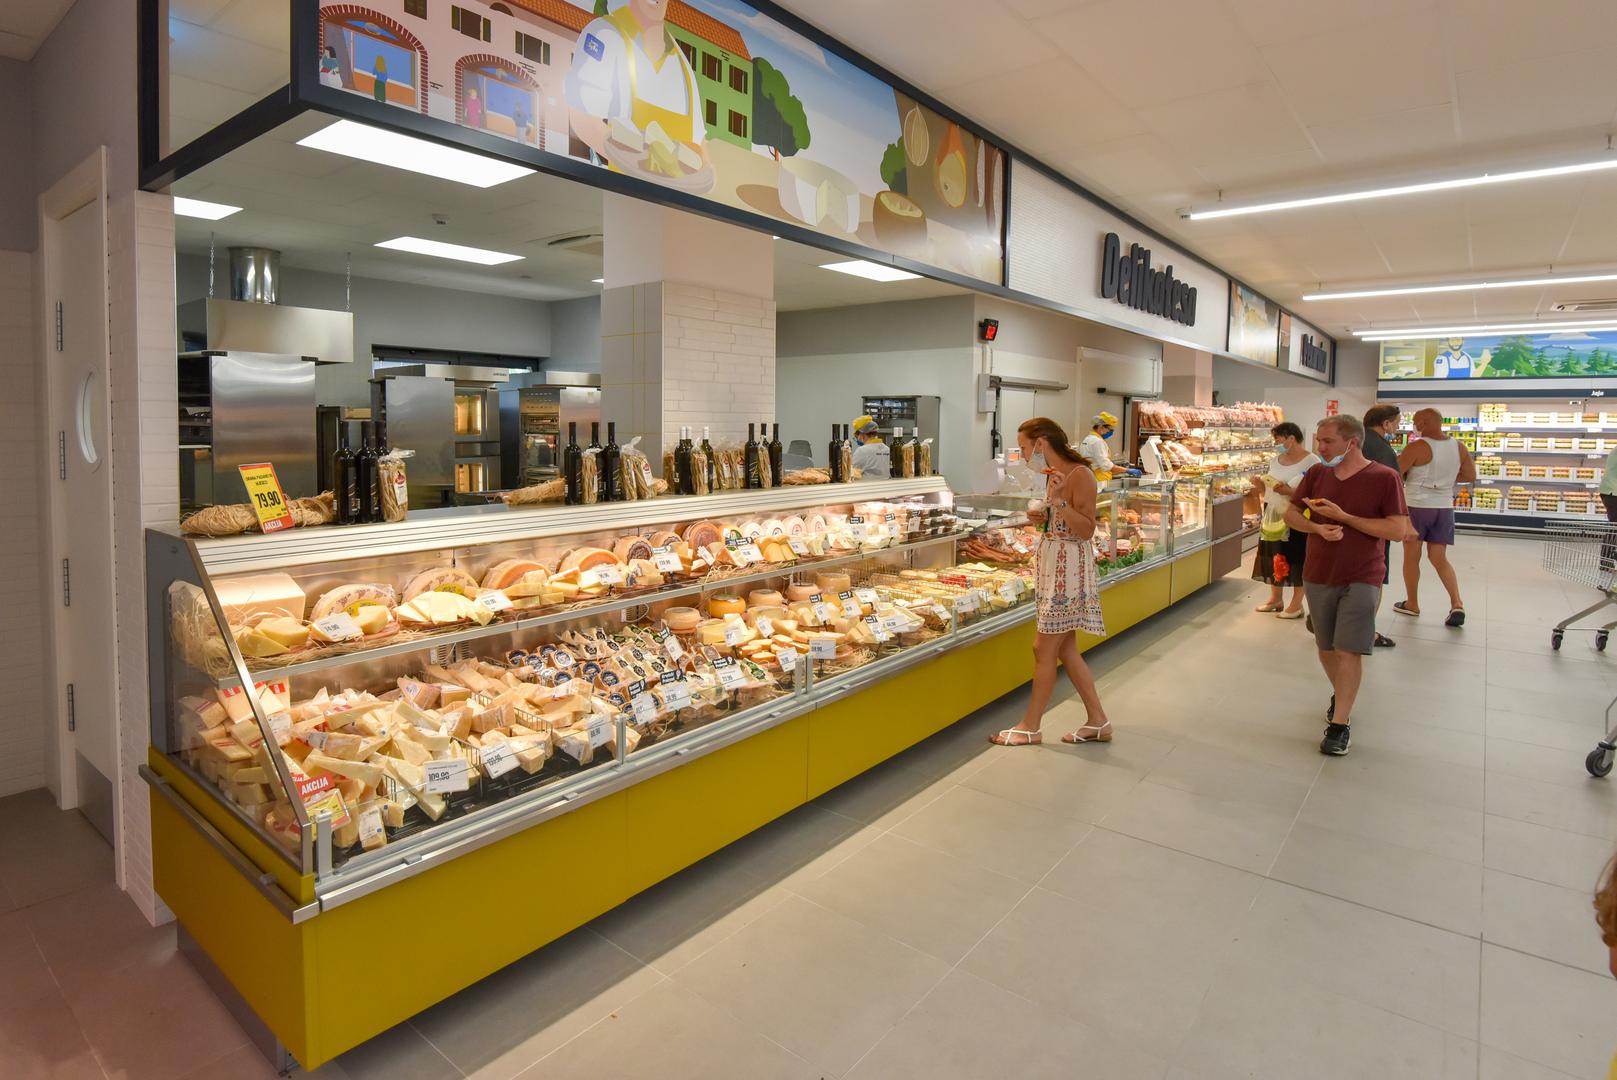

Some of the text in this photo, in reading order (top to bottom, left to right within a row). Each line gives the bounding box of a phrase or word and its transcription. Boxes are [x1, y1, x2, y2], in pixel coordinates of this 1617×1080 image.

[1101, 232, 1197, 327] Delikatesa
[254, 490, 281, 508] 79,90
[301, 776, 329, 796] AKCIJA
